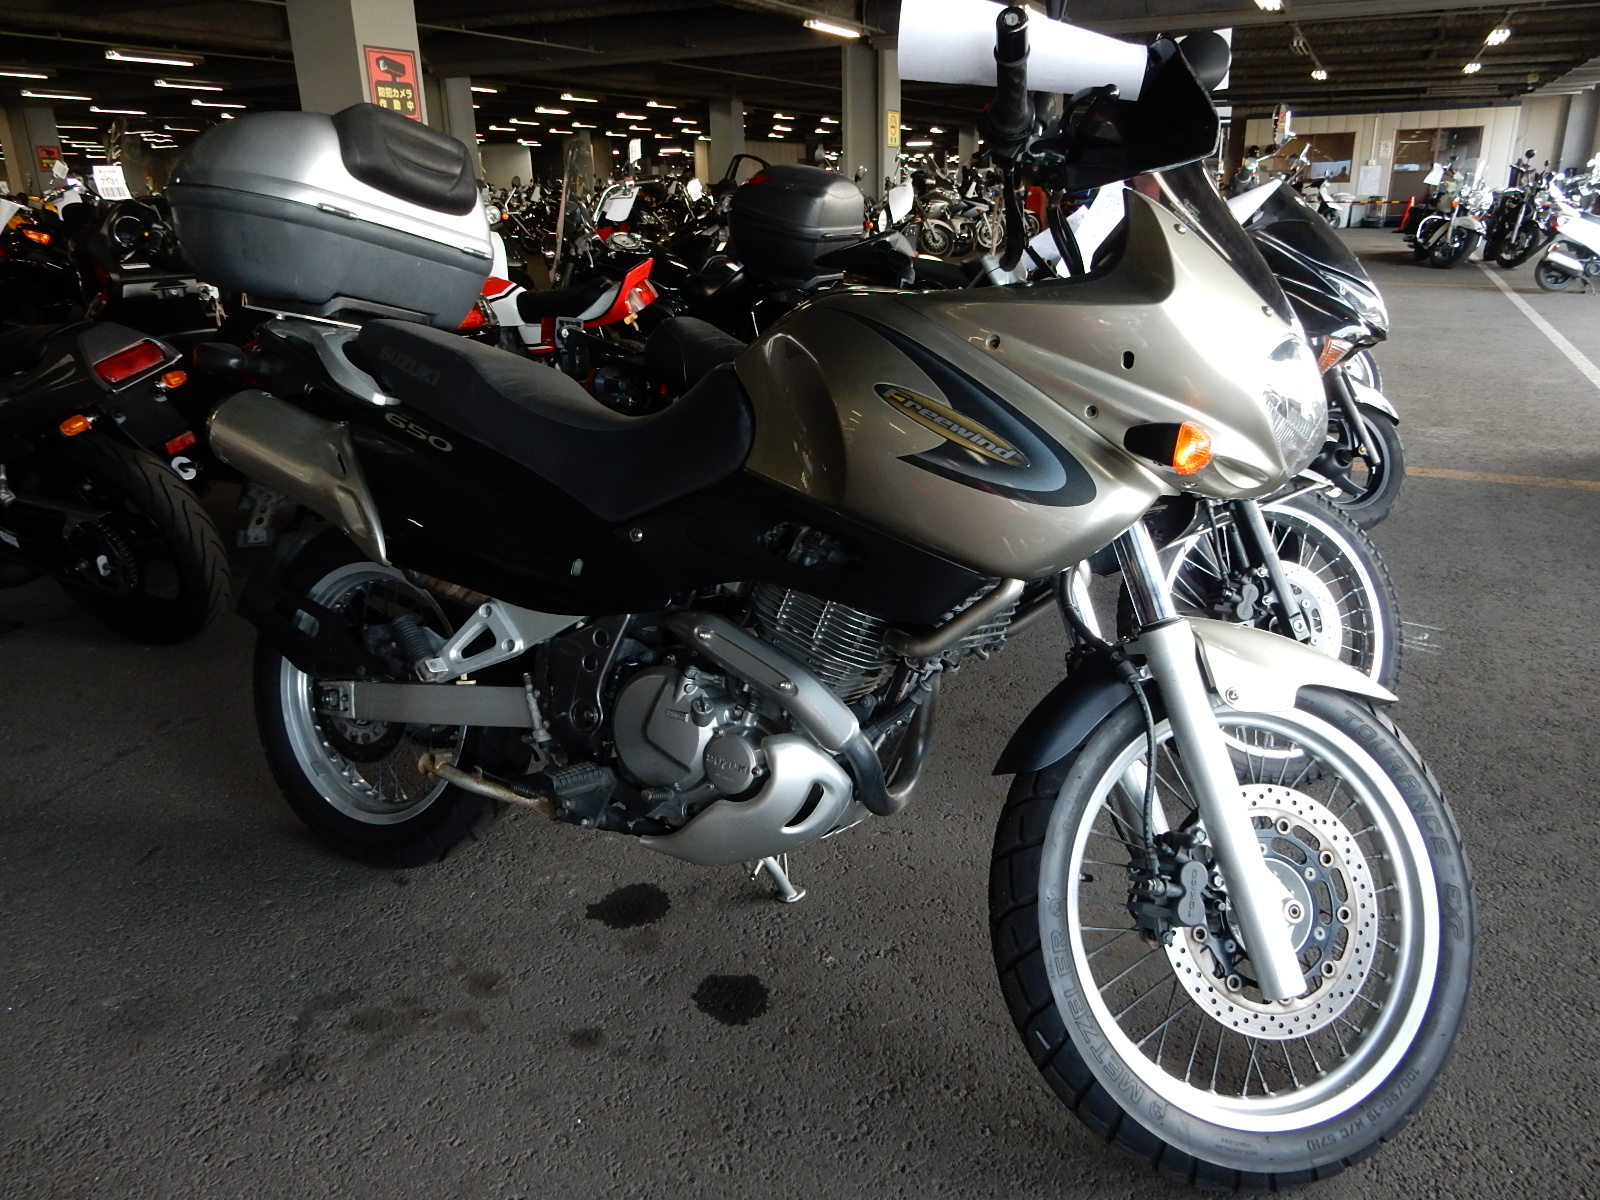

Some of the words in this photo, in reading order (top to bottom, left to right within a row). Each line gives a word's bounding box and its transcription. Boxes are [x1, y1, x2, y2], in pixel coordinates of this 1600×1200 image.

[378, 86, 412, 99] 防犯カメラ
[380, 346, 441, 386] SUZUKI
[384, 412, 453, 452] 650
[882, 388, 1017, 459] Freewind
[706, 754, 749, 774] SUZUKI
[1340, 709, 1452, 857] TOURANCE
[1187, 869, 1198, 919] TOKICO
[1050, 929, 1146, 1105] METZELER
